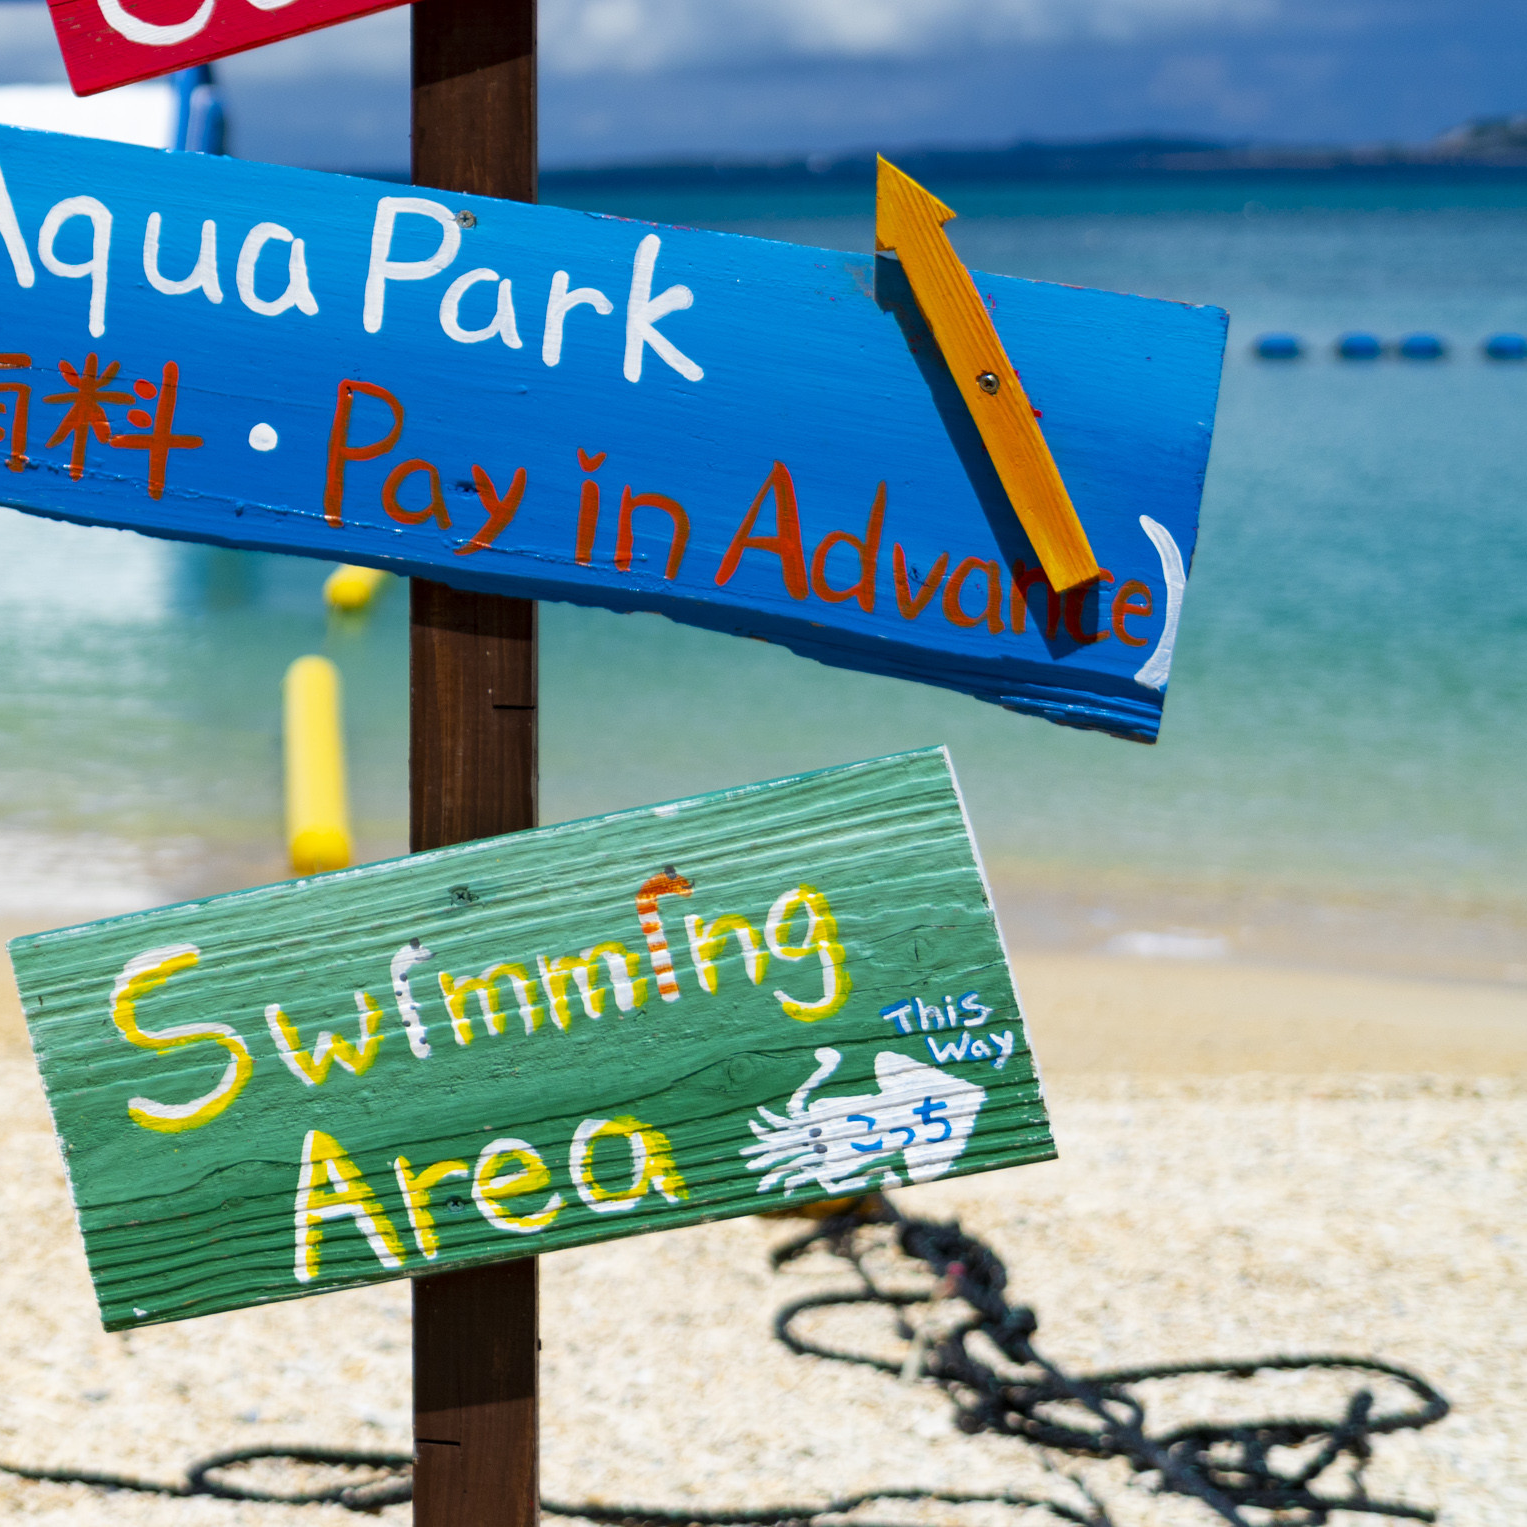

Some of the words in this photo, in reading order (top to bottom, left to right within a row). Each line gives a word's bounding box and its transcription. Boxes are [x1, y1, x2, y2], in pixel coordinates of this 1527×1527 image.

[363, 196, 704, 383] Park
[324, 378, 527, 556] Pay
[575, 446, 691, 580] in
[109, 865, 853, 1134] Swimming
[880, 990, 993, 1035] This
[925, 1030, 1015, 1070] Way
[293, 1115, 688, 1284] Area
[846, 1096, 952, 1153] こっち
